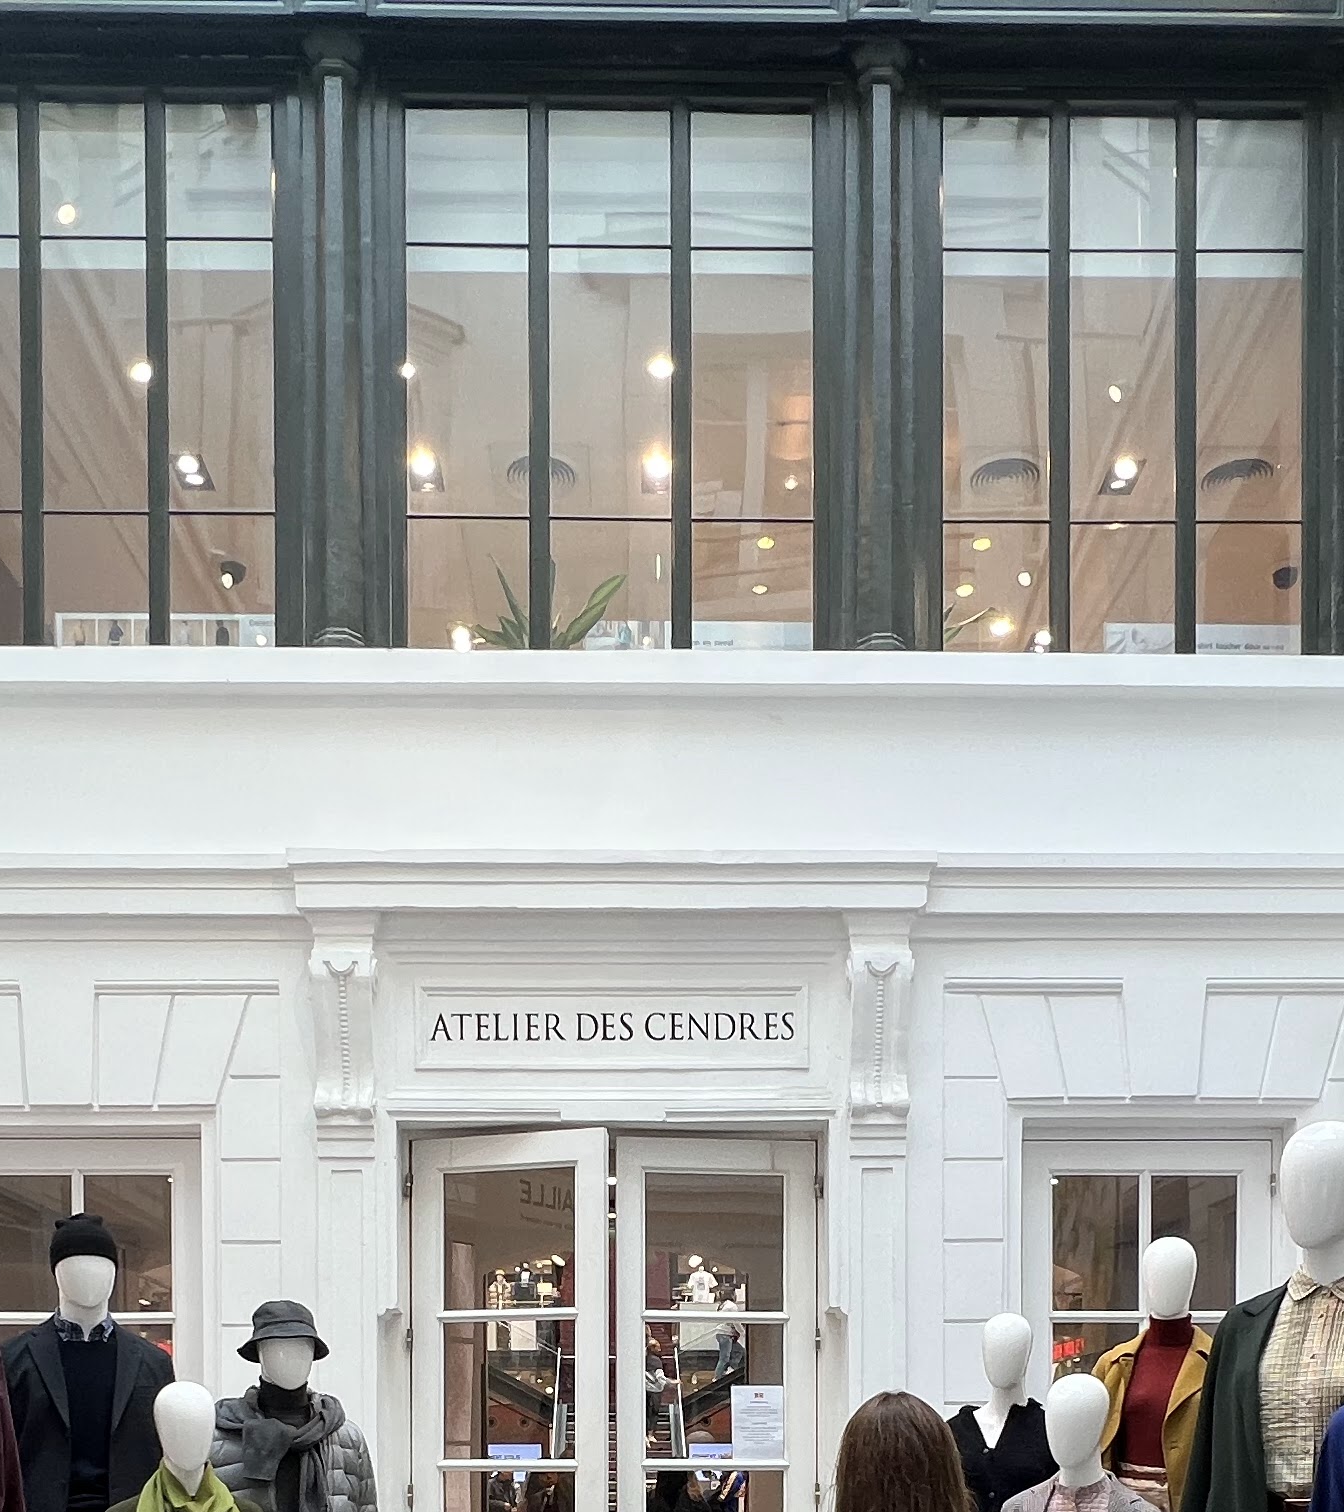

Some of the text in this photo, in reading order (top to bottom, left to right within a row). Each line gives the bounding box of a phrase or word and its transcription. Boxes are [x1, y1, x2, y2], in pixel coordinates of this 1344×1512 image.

[430, 1012, 796, 1042] ATELIER DES CENDRES
